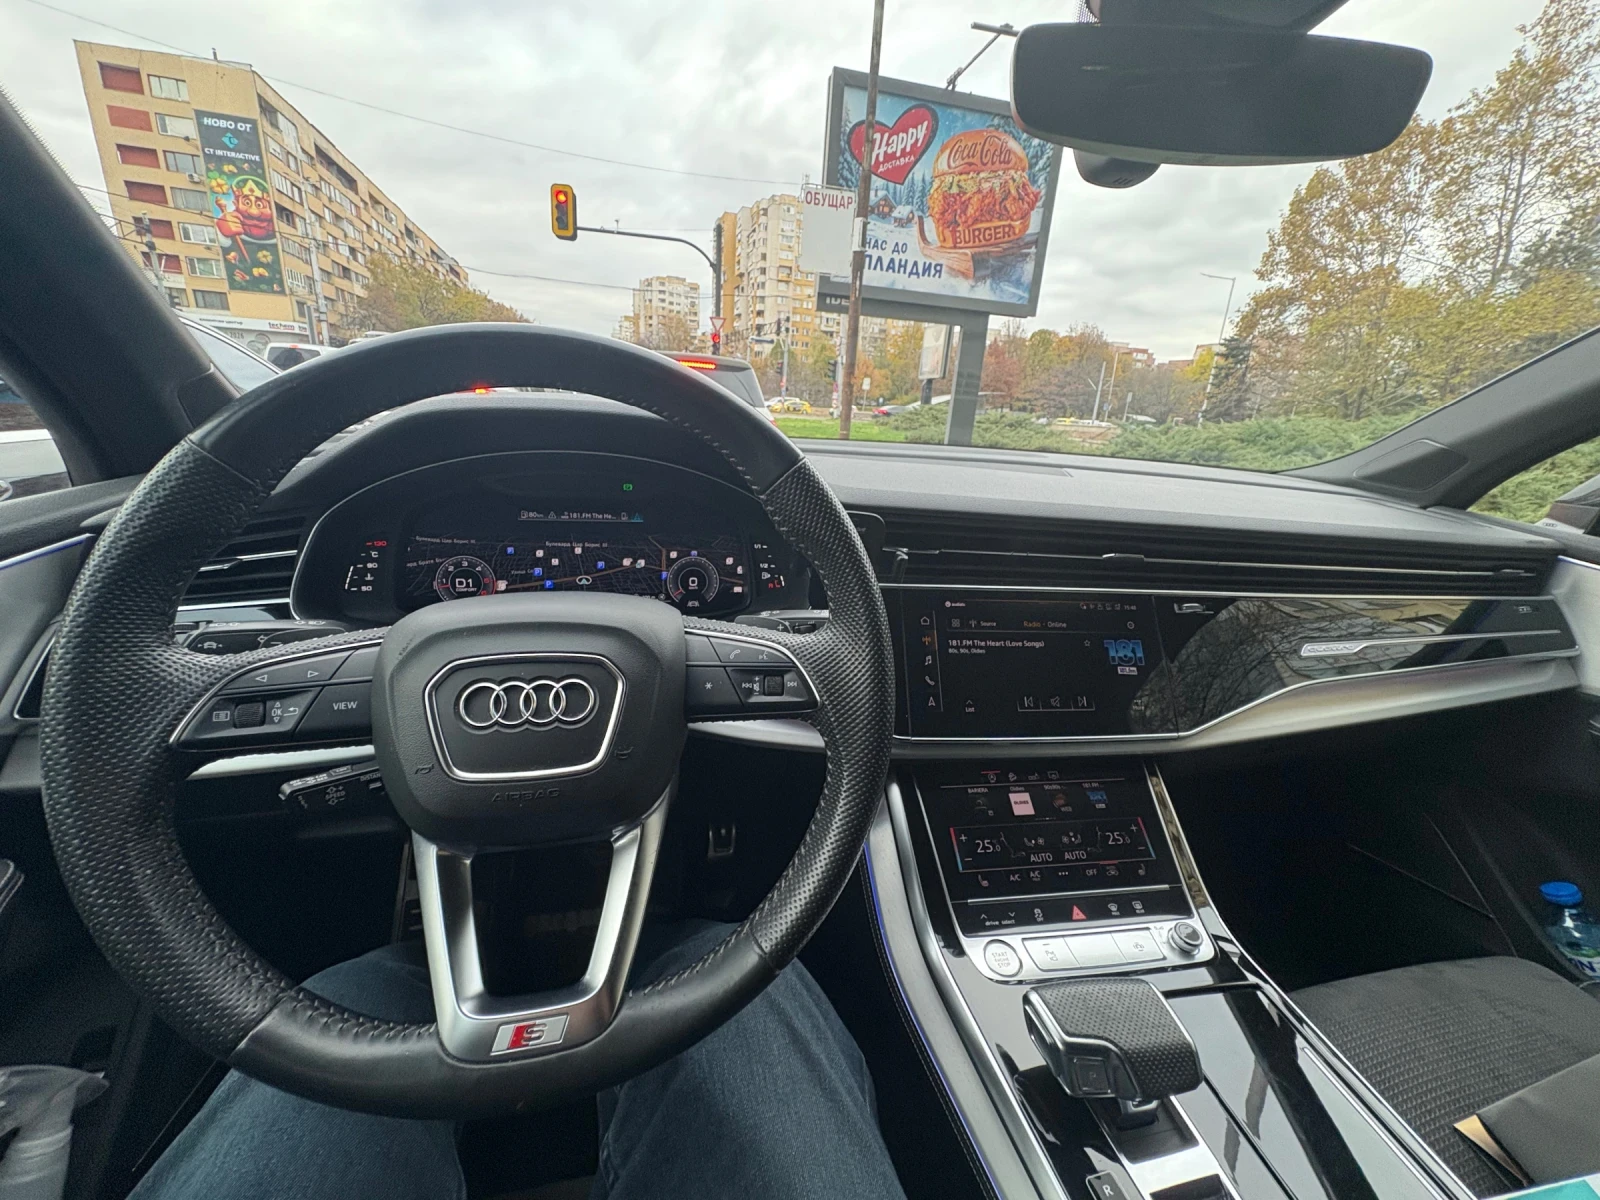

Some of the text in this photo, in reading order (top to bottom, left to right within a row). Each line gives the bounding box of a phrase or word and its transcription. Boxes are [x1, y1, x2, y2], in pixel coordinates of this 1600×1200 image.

[203, 117, 252, 132] НОВО ОТ
[871, 120, 929, 165] Happy
[204, 147, 260, 162] CT INTERACTIVE
[877, 155, 915, 173] ДОСТАВКА
[804, 191, 854, 211] ОБУЩАР
[955, 223, 1013, 246] BURGER
[892, 241, 908, 255] ДО
[864, 253, 944, 279] ПЛАНДИЯ
[455, 578, 473, 588] D1
[688, 577, 698, 586] 0
[948, 639, 972, 647] 181.FM
[1005, 640, 1023, 648] (Love
[1023, 640, 1045, 649] Songs)
[1103, 639, 1145, 666] 181
[332, 701, 358, 711] VIEW
[271, 708, 282, 717] OK
[360, 773, 381, 782] DISTAN
[325, 790, 346, 801] SPEED
[491, 787, 560, 802] AIRBAG
[1030, 852, 1053, 863] AUTO
[1064, 850, 1087, 860] AUTO
[1009, 873, 1021, 882] A/C
[1029, 870, 1041, 878] A/C
[1102, 1184, 1114, 1197] R
